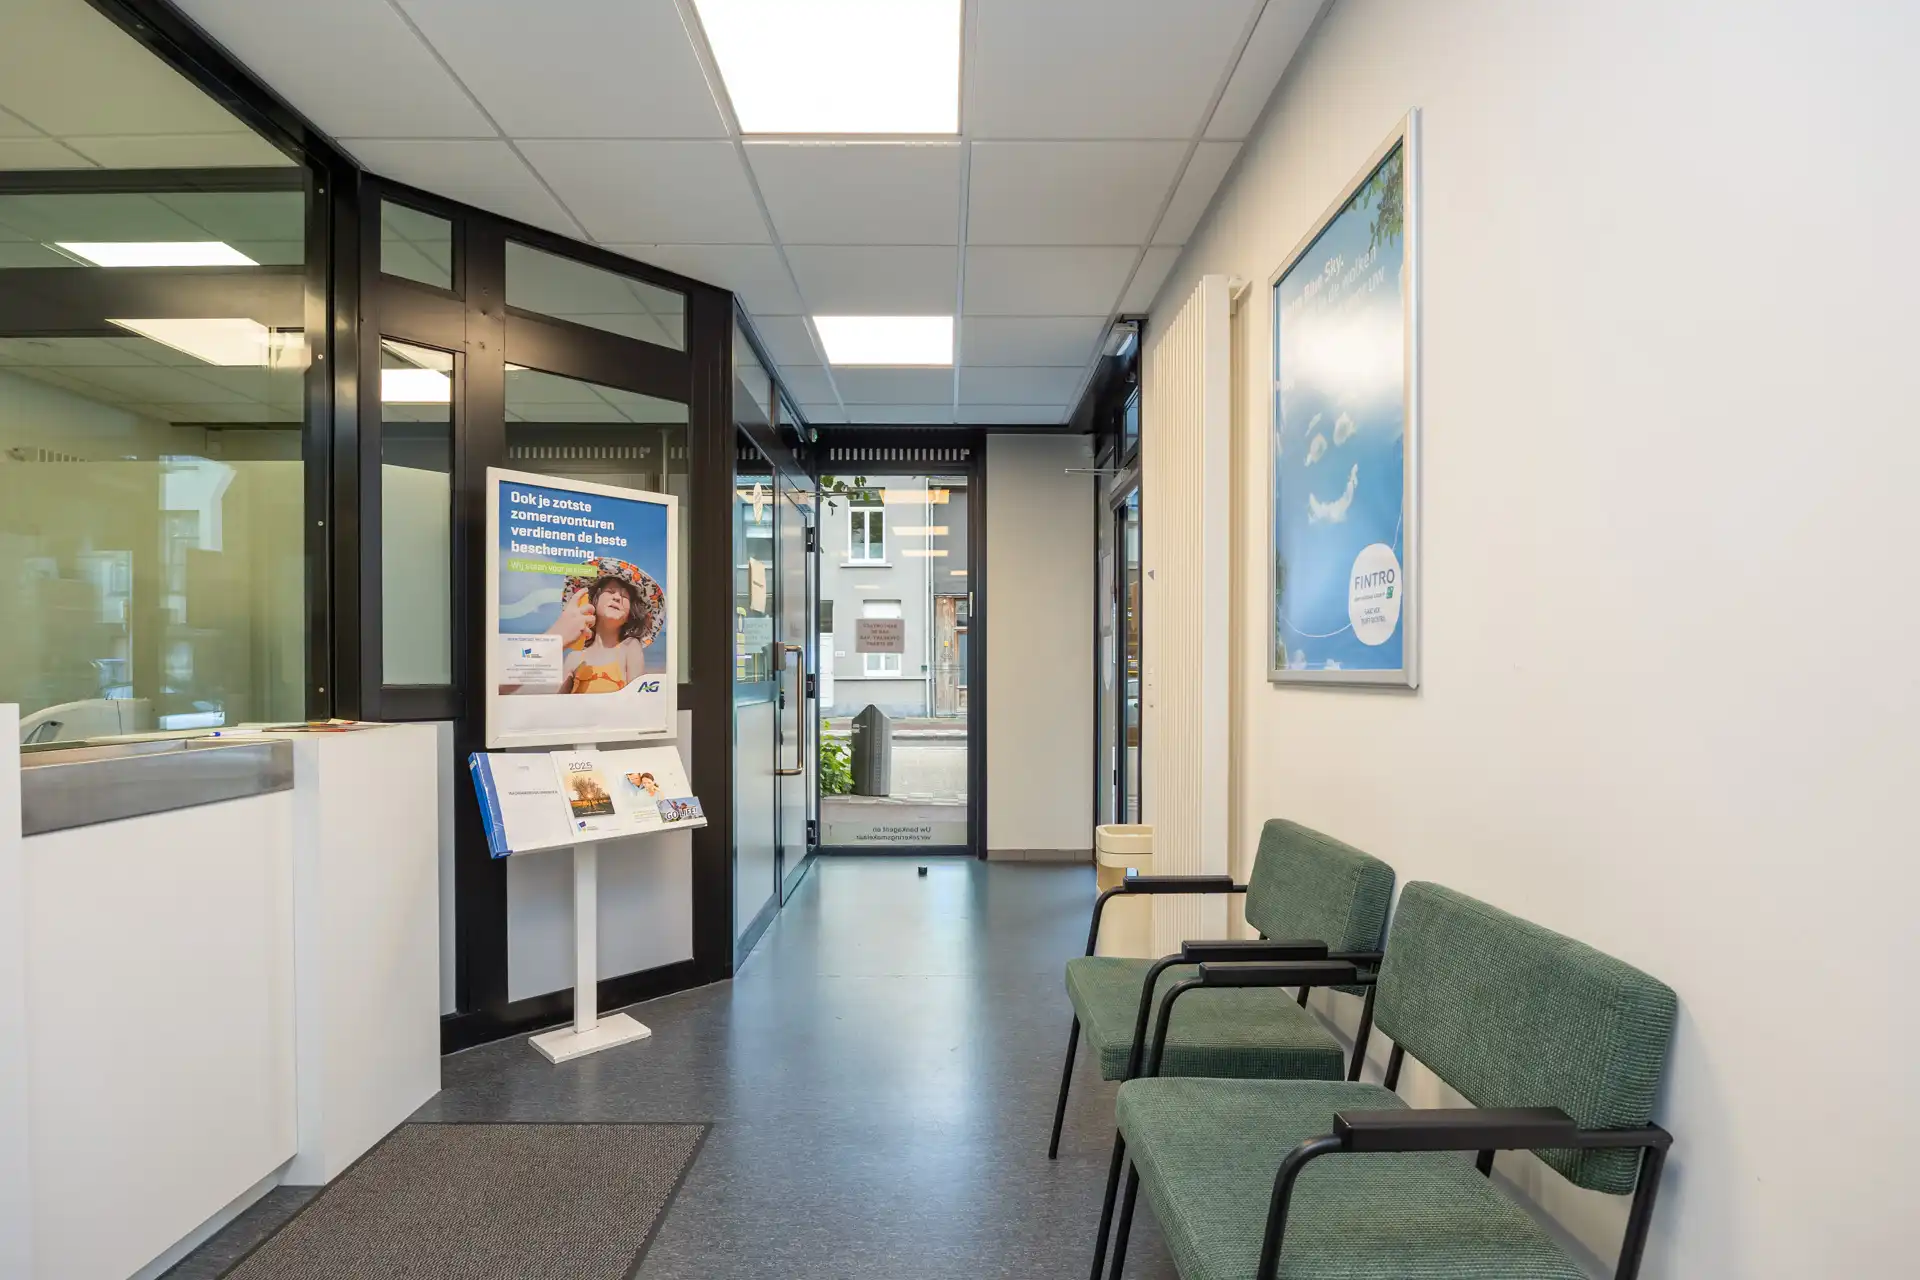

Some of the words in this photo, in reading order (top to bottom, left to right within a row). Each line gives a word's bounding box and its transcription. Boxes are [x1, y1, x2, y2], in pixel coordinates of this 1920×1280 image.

[511, 491, 537, 505] Ook
[538, 495, 550, 508] je
[552, 499, 592, 512] zotste
[511, 510, 615, 530] zomeravonturen
[511, 526, 576, 542] verdienen
[577, 531, 593, 544] de
[595, 532, 628, 547] beste
[511, 540, 598, 561] bescherming.
[1355, 568, 1395, 590] FINTRO
[638, 681, 660, 693] AG
[569, 761, 593, 772] 2025
[666, 809, 678, 820] GO
